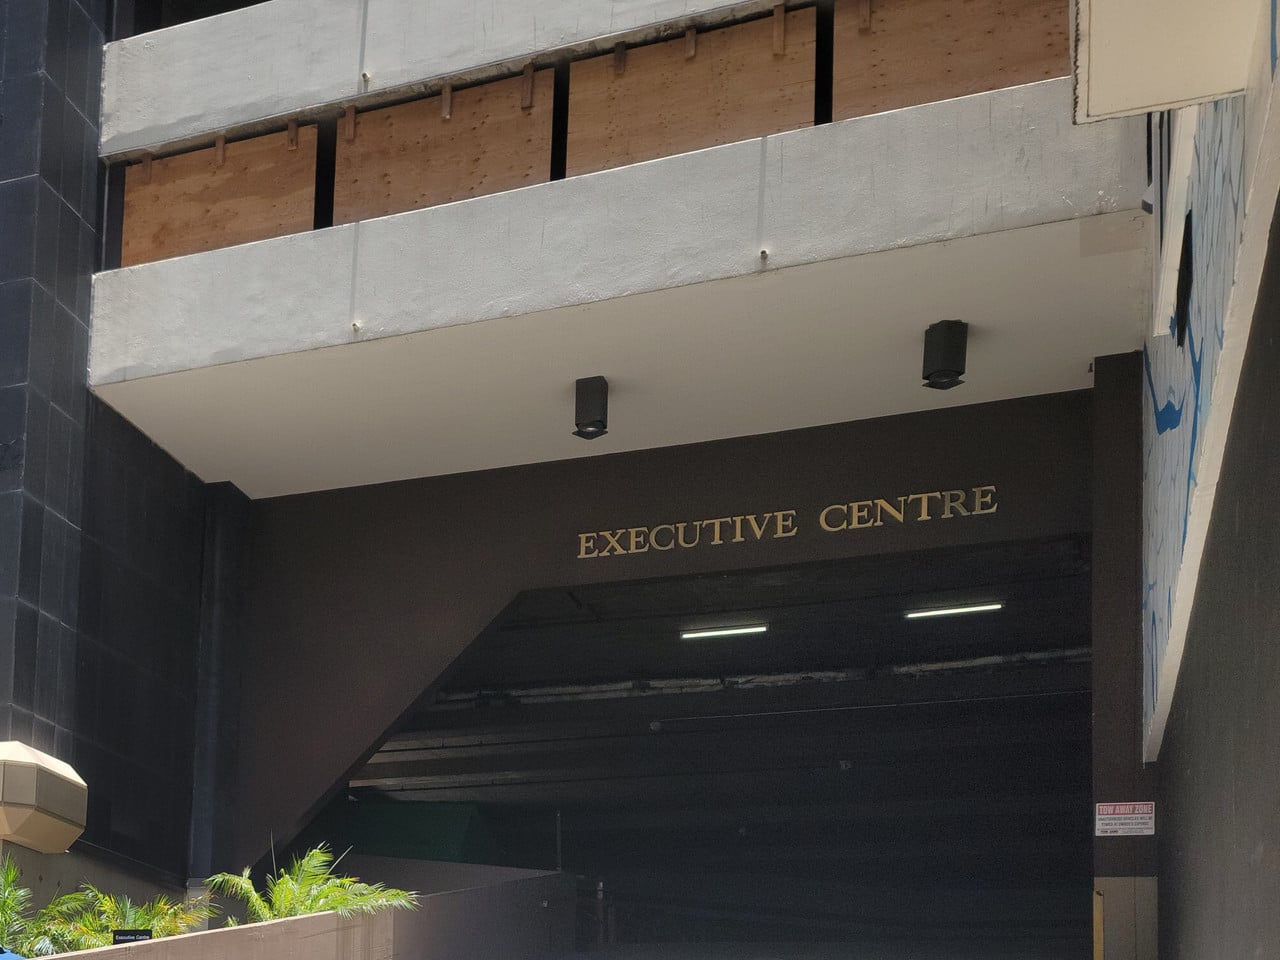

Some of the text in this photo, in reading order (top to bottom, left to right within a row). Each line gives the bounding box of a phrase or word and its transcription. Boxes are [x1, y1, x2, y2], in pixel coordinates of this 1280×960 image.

[577, 485, 999, 559] EXECUTIVE CENTRE
[1099, 804, 1153, 815] TOW AWAY ZONE
